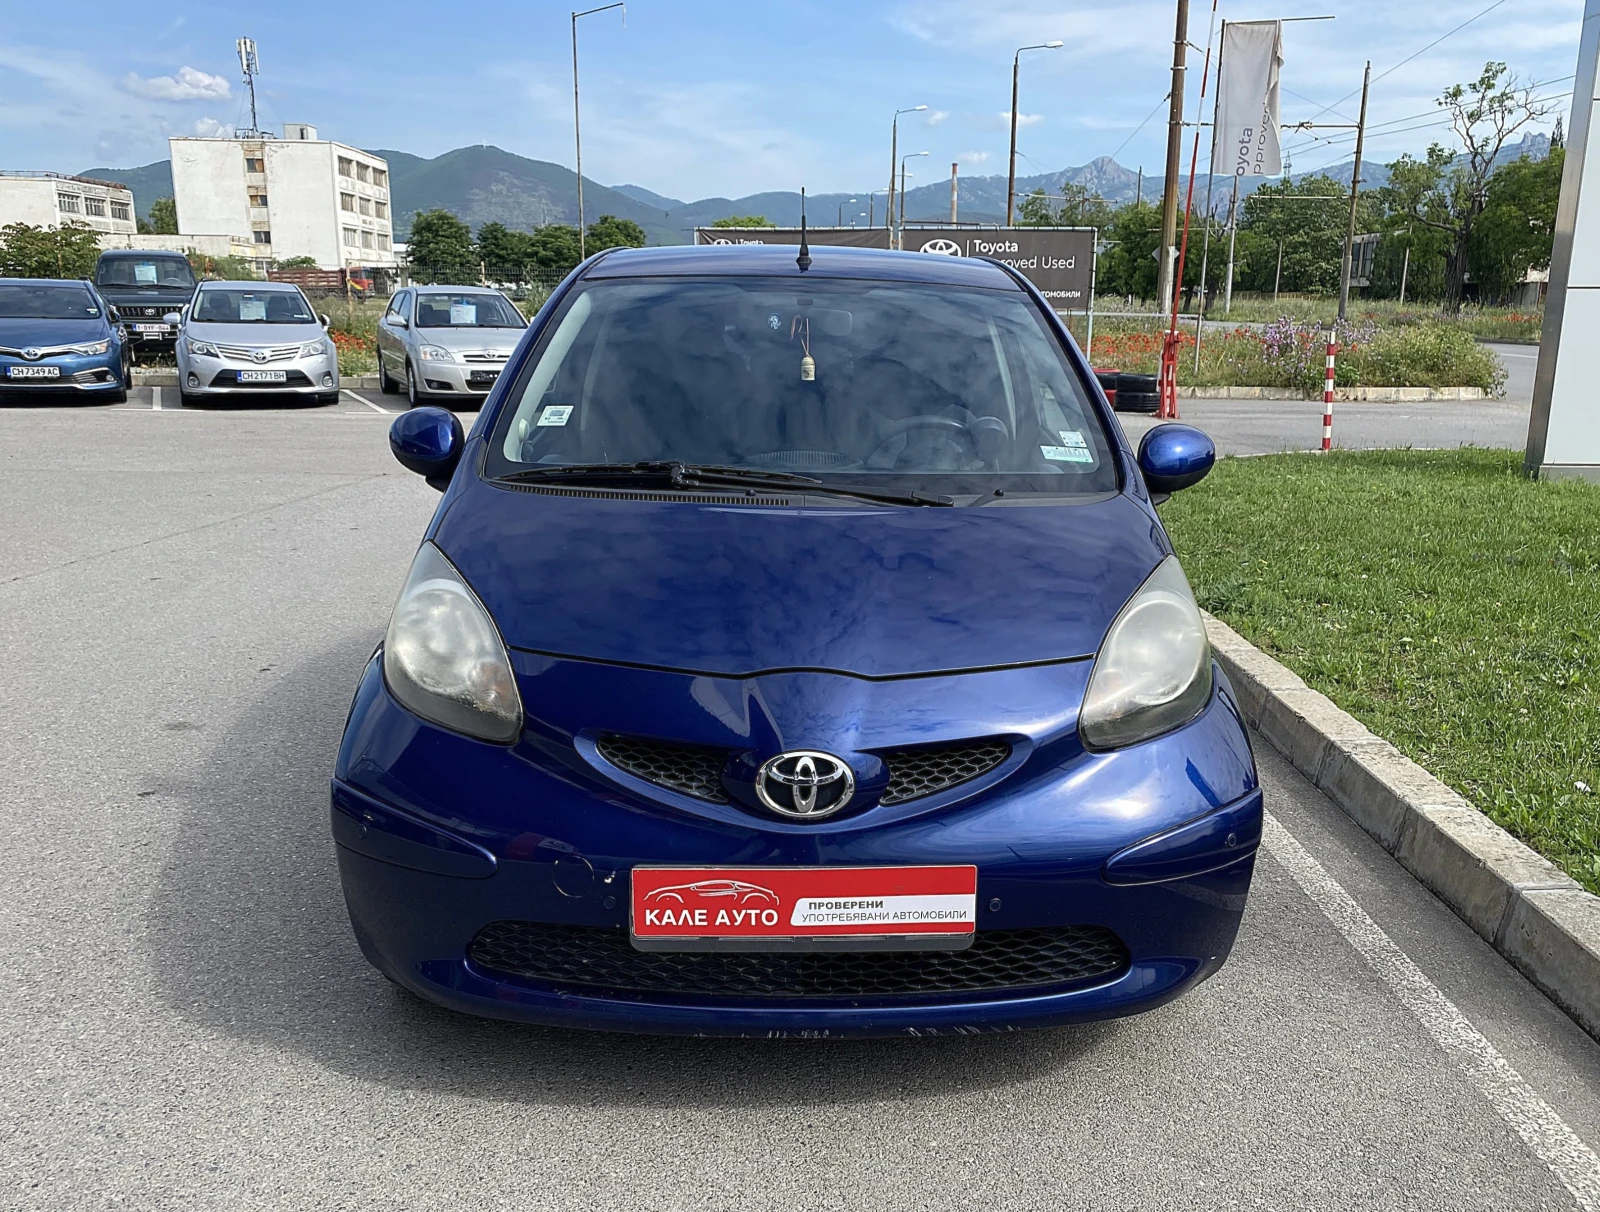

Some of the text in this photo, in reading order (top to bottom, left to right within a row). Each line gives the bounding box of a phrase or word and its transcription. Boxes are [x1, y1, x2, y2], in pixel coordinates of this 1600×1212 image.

[973, 239, 1019, 255] Toyota
[1042, 255, 1075, 269] Used
[808, 900, 884, 911] ПРОВЕРЕНИ
[645, 909, 779, 926] КАЛЕ АУТО
[801, 910, 967, 923] УПОТРЕБЯВАНИ АВТОМОБИЛИ
